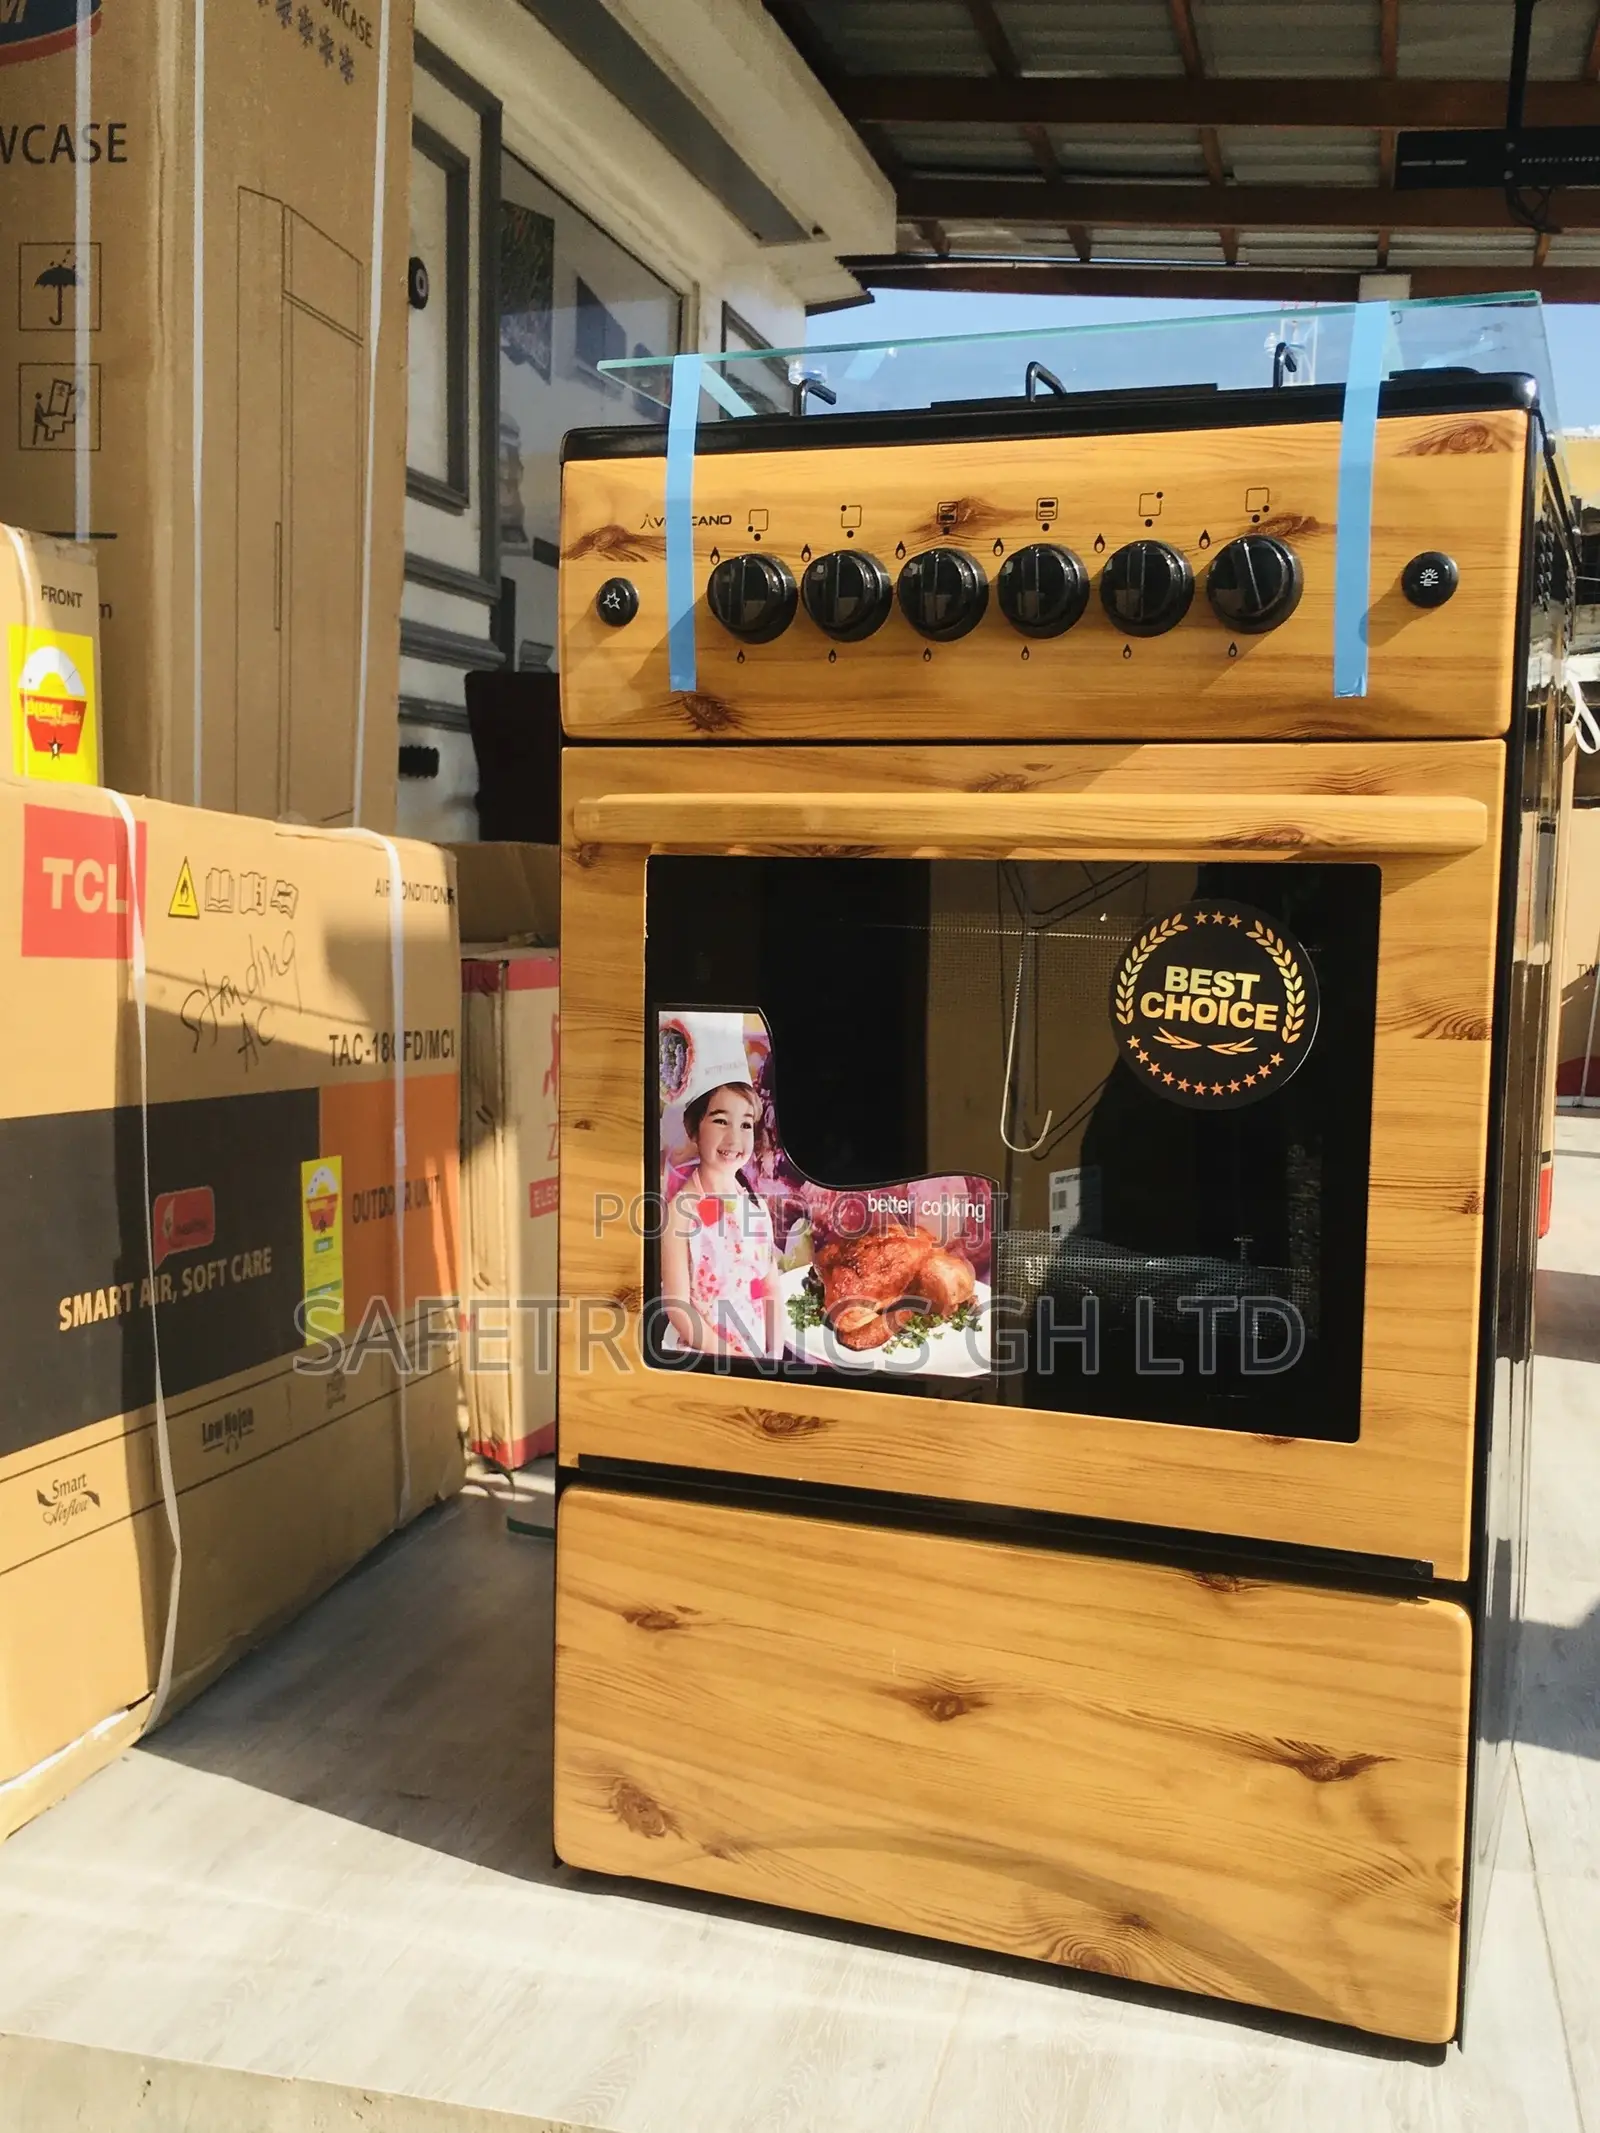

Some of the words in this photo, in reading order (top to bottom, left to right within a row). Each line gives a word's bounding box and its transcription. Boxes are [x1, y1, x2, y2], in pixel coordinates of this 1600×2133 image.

[653, 515, 732, 527] VCANO
[40, 584, 83, 609] FRONT
[42, 856, 129, 914] TCL
[1164, 965, 1261, 1001] BEST
[1139, 991, 1280, 1032] CHOICE
[867, 1193, 914, 1215] better
[921, 1196, 986, 1223] cooking
[59, 1281, 135, 1332] SMART
[139, 1273, 177, 1309] AIR,
[181, 1258, 228, 1298] SOFT
[230, 1247, 273, 1284] CARE
[202, 1419, 223, 1446] Low
[52, 1473, 87, 1500] Smart
